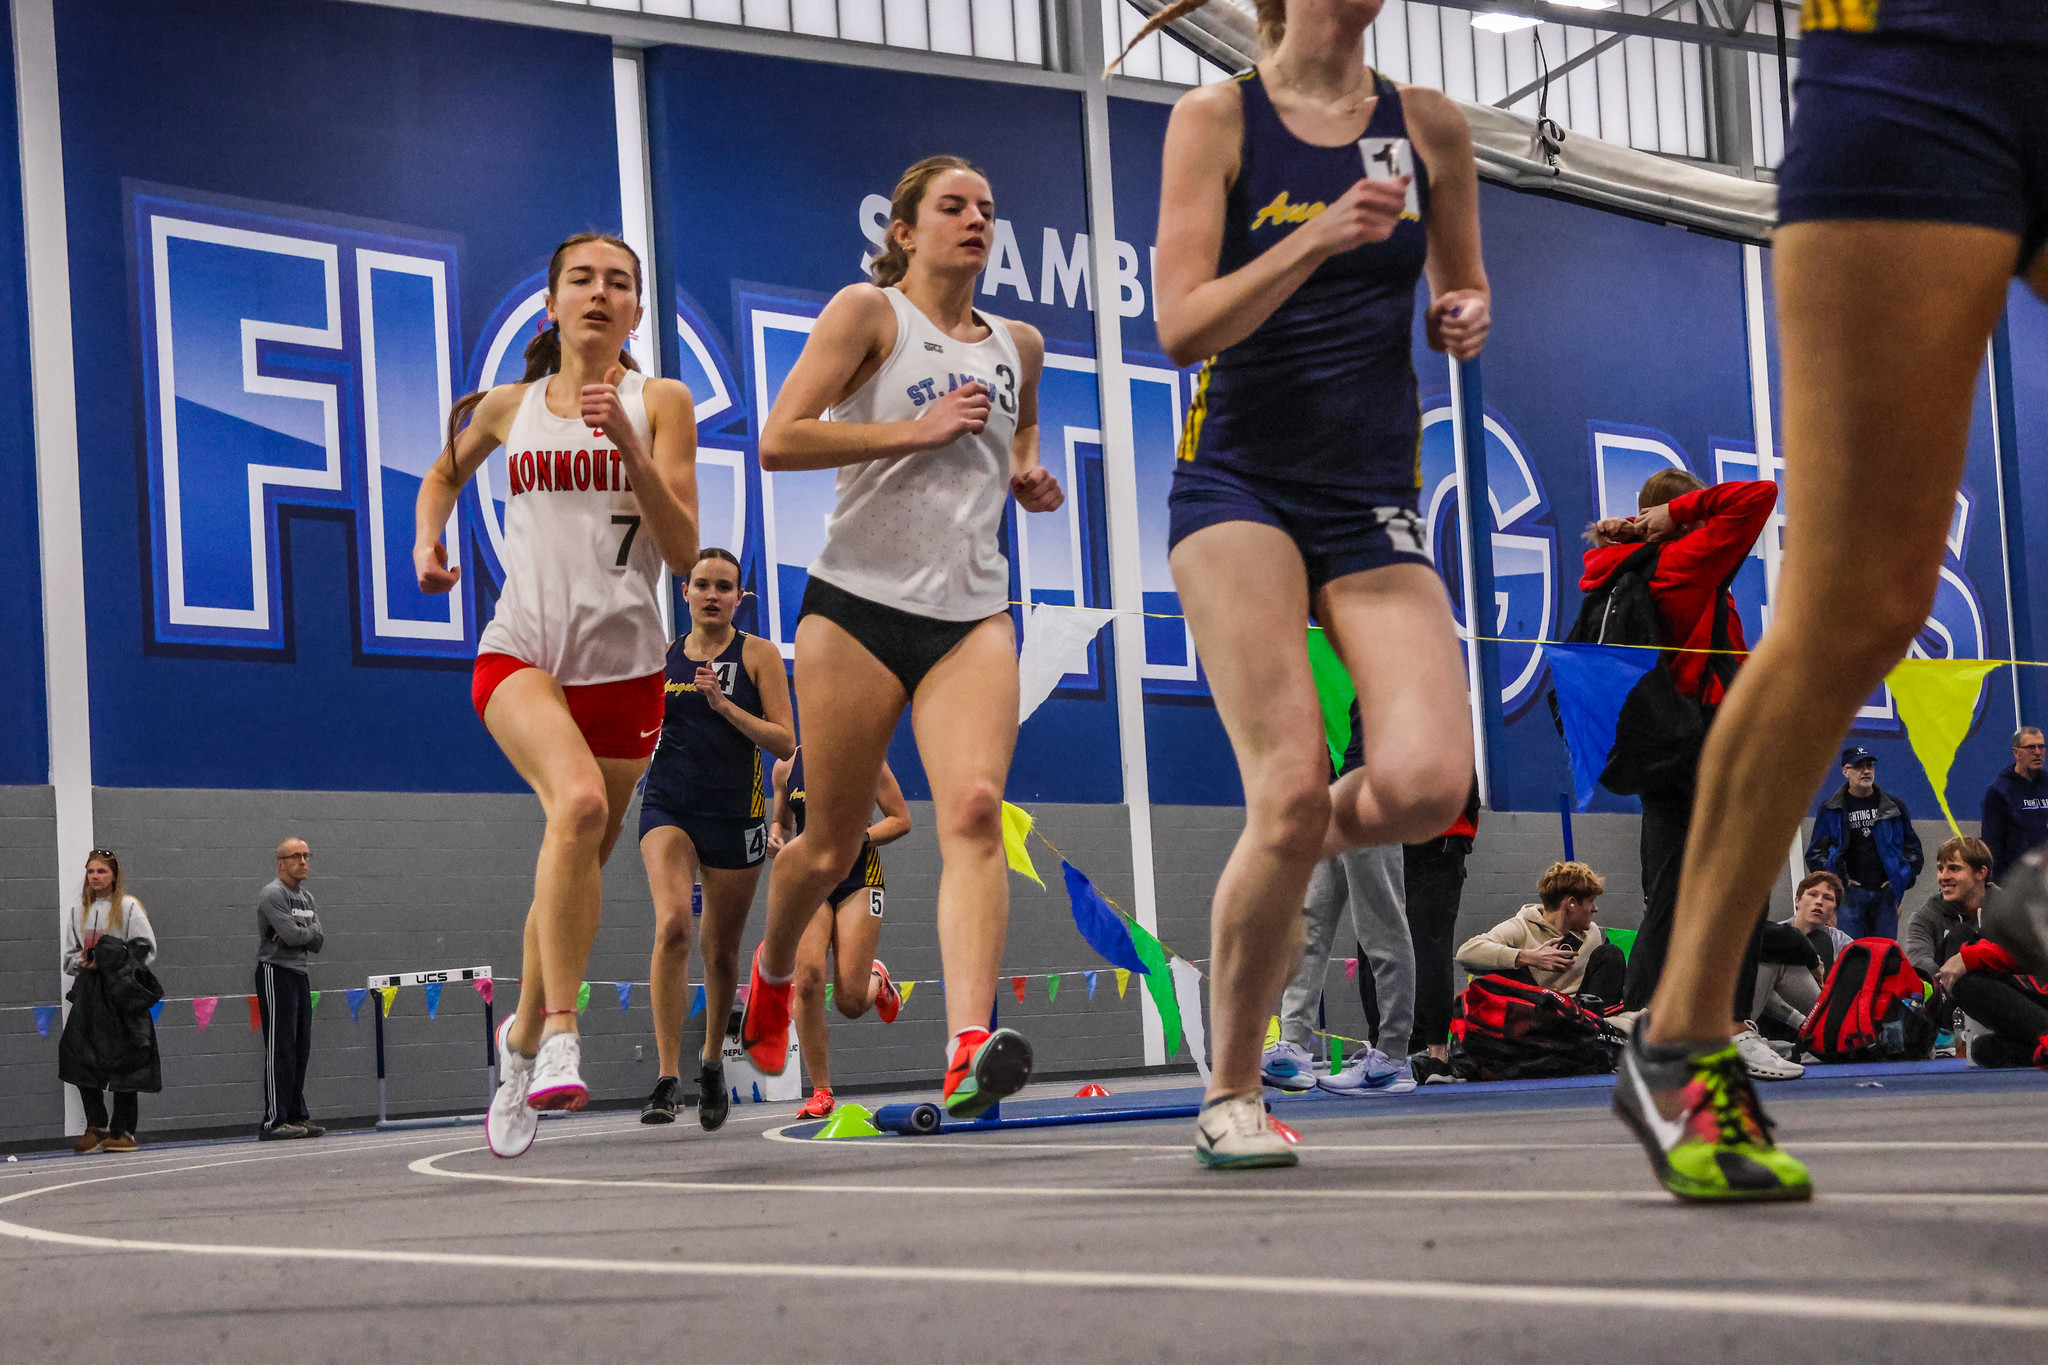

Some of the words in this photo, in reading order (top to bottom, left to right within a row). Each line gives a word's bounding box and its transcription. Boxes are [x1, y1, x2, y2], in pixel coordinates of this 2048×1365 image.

[907, 377, 945, 407] ST.
[995, 364, 1016, 414] 3
[509, 449, 633, 497] MONMOUT
[611, 515, 641, 566] 7
[716, 664, 731, 691] 4
[750, 828, 765, 858] 4
[872, 891, 883, 916] 5
[416, 972, 448, 984] UCS
[723, 1049, 744, 1057] REPU
